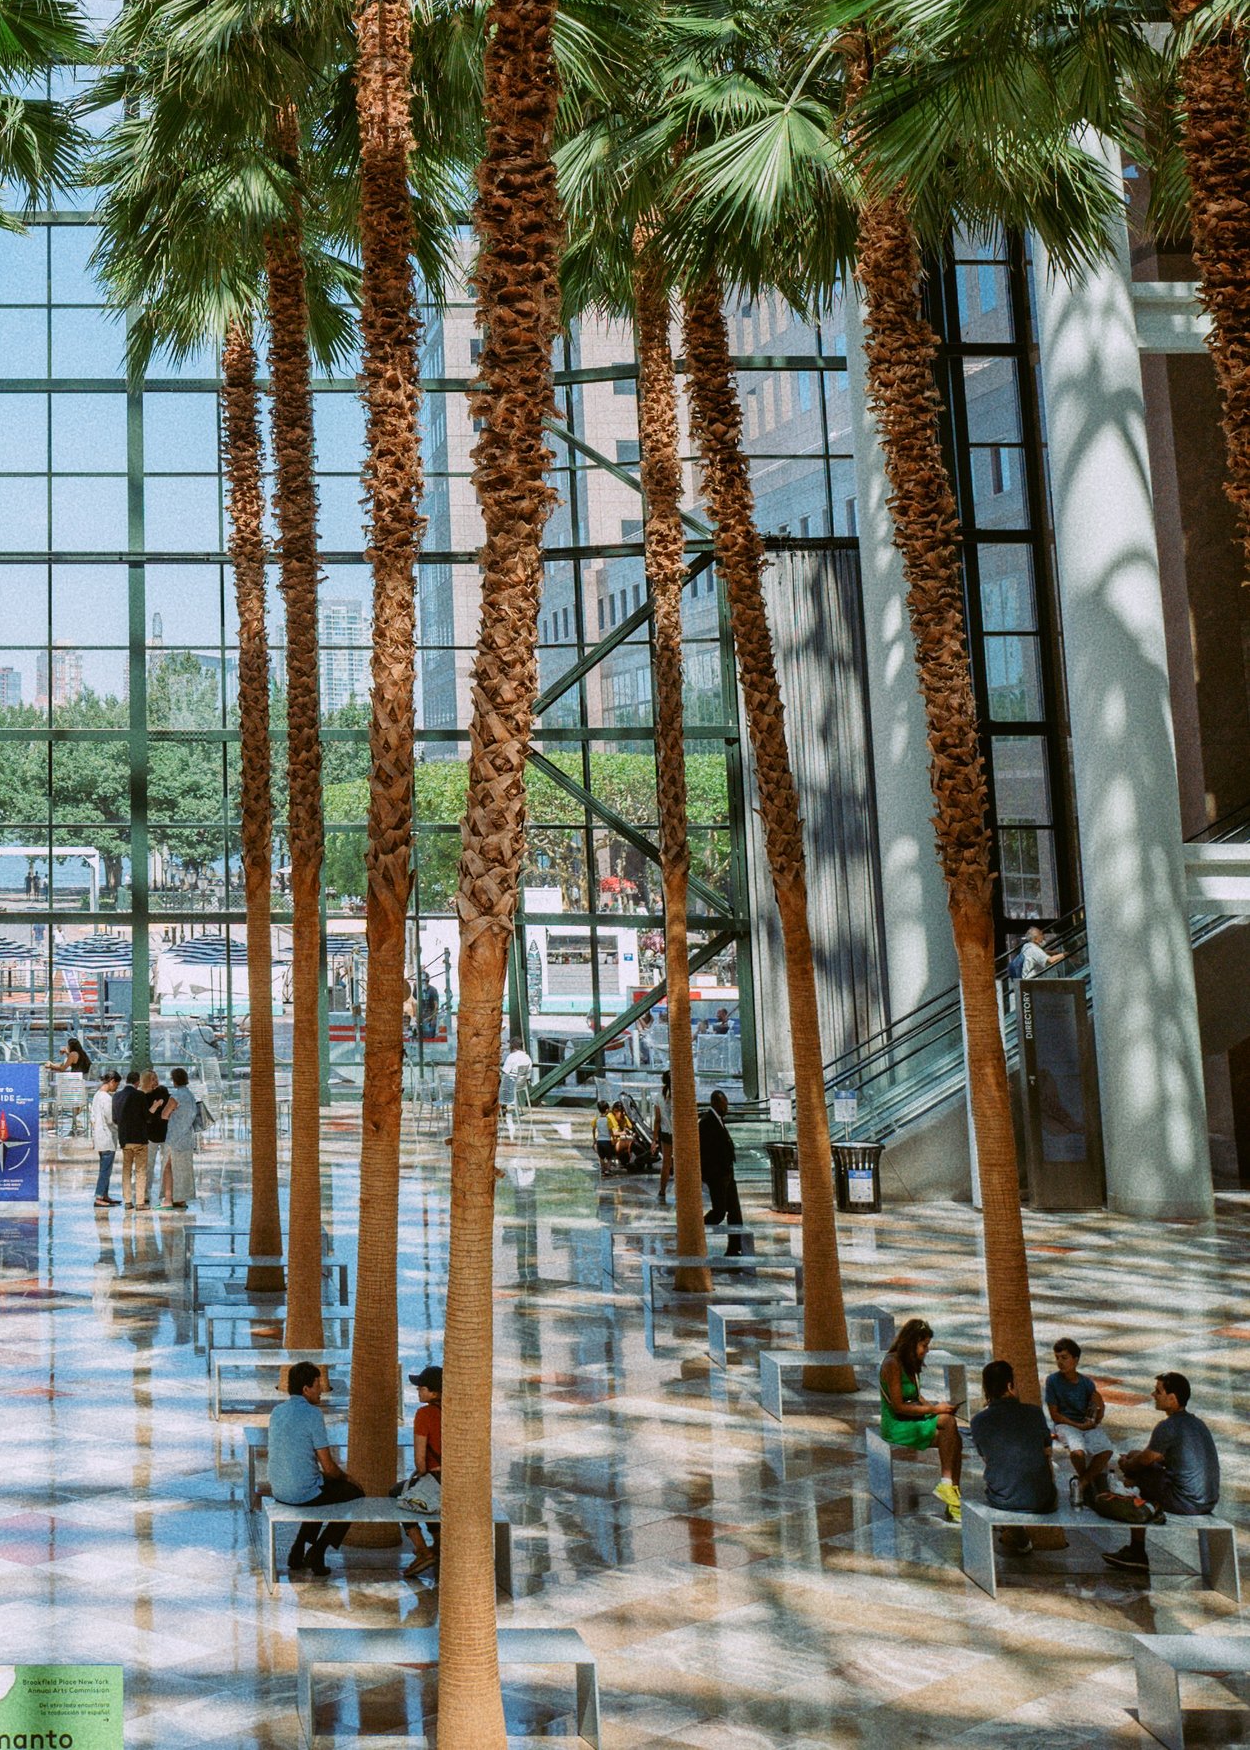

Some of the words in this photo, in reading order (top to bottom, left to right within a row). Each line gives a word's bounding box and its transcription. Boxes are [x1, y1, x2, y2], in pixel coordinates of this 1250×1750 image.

[1023, 991, 1034, 1039] DIRECTORY
[22, 1678, 57, 1686] Brookfield
[58, 1678, 77, 1686] Place
[78, 1678, 93, 1686] New
[94, 1678, 110, 1686] York
